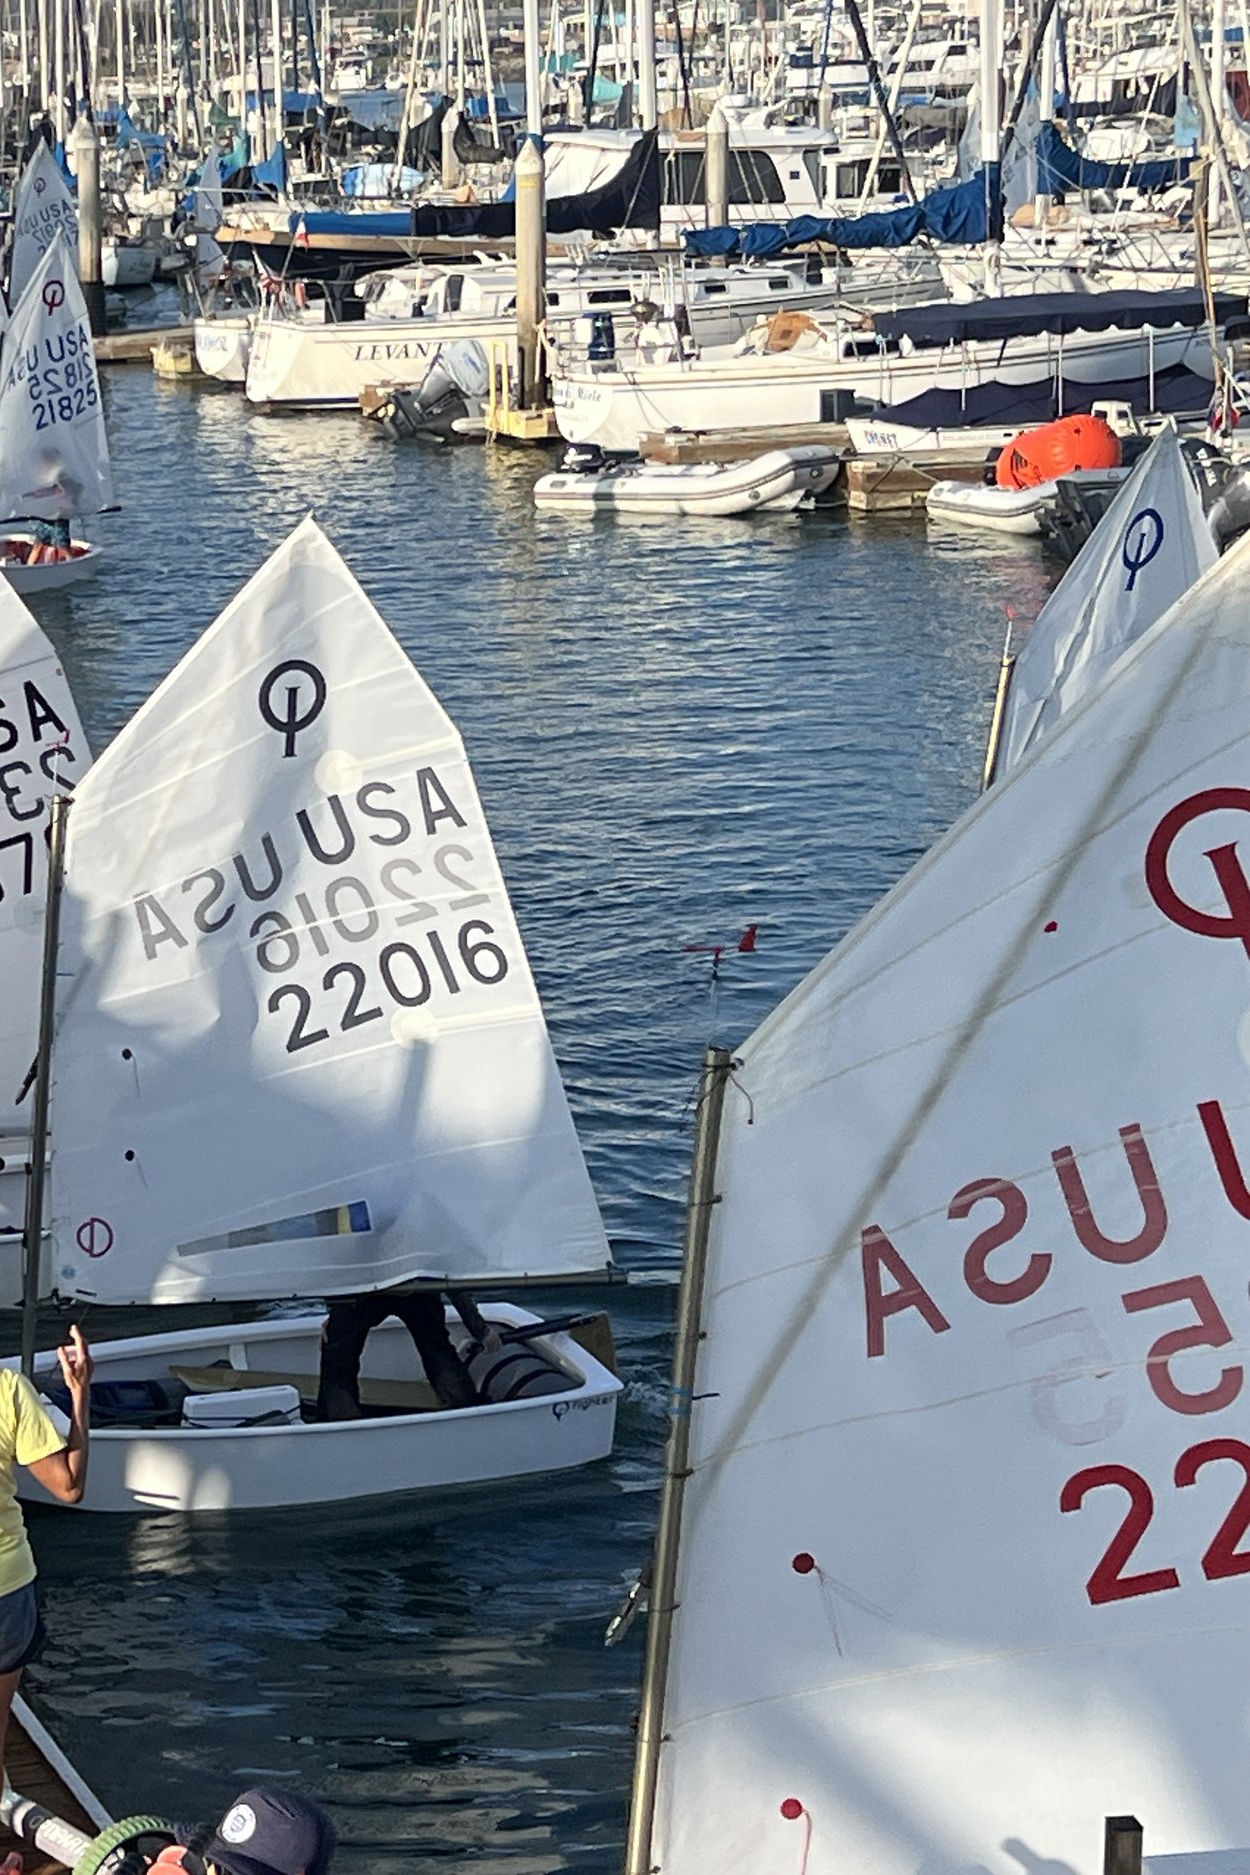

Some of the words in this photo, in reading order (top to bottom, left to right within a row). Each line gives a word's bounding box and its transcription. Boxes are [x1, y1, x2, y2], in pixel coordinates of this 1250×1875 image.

[40, 199, 72, 222] USA
[45, 323, 89, 363] USA
[32, 379, 98, 431] 21825
[296, 766, 468, 865] USA
[268, 919, 509, 1053] 22016
